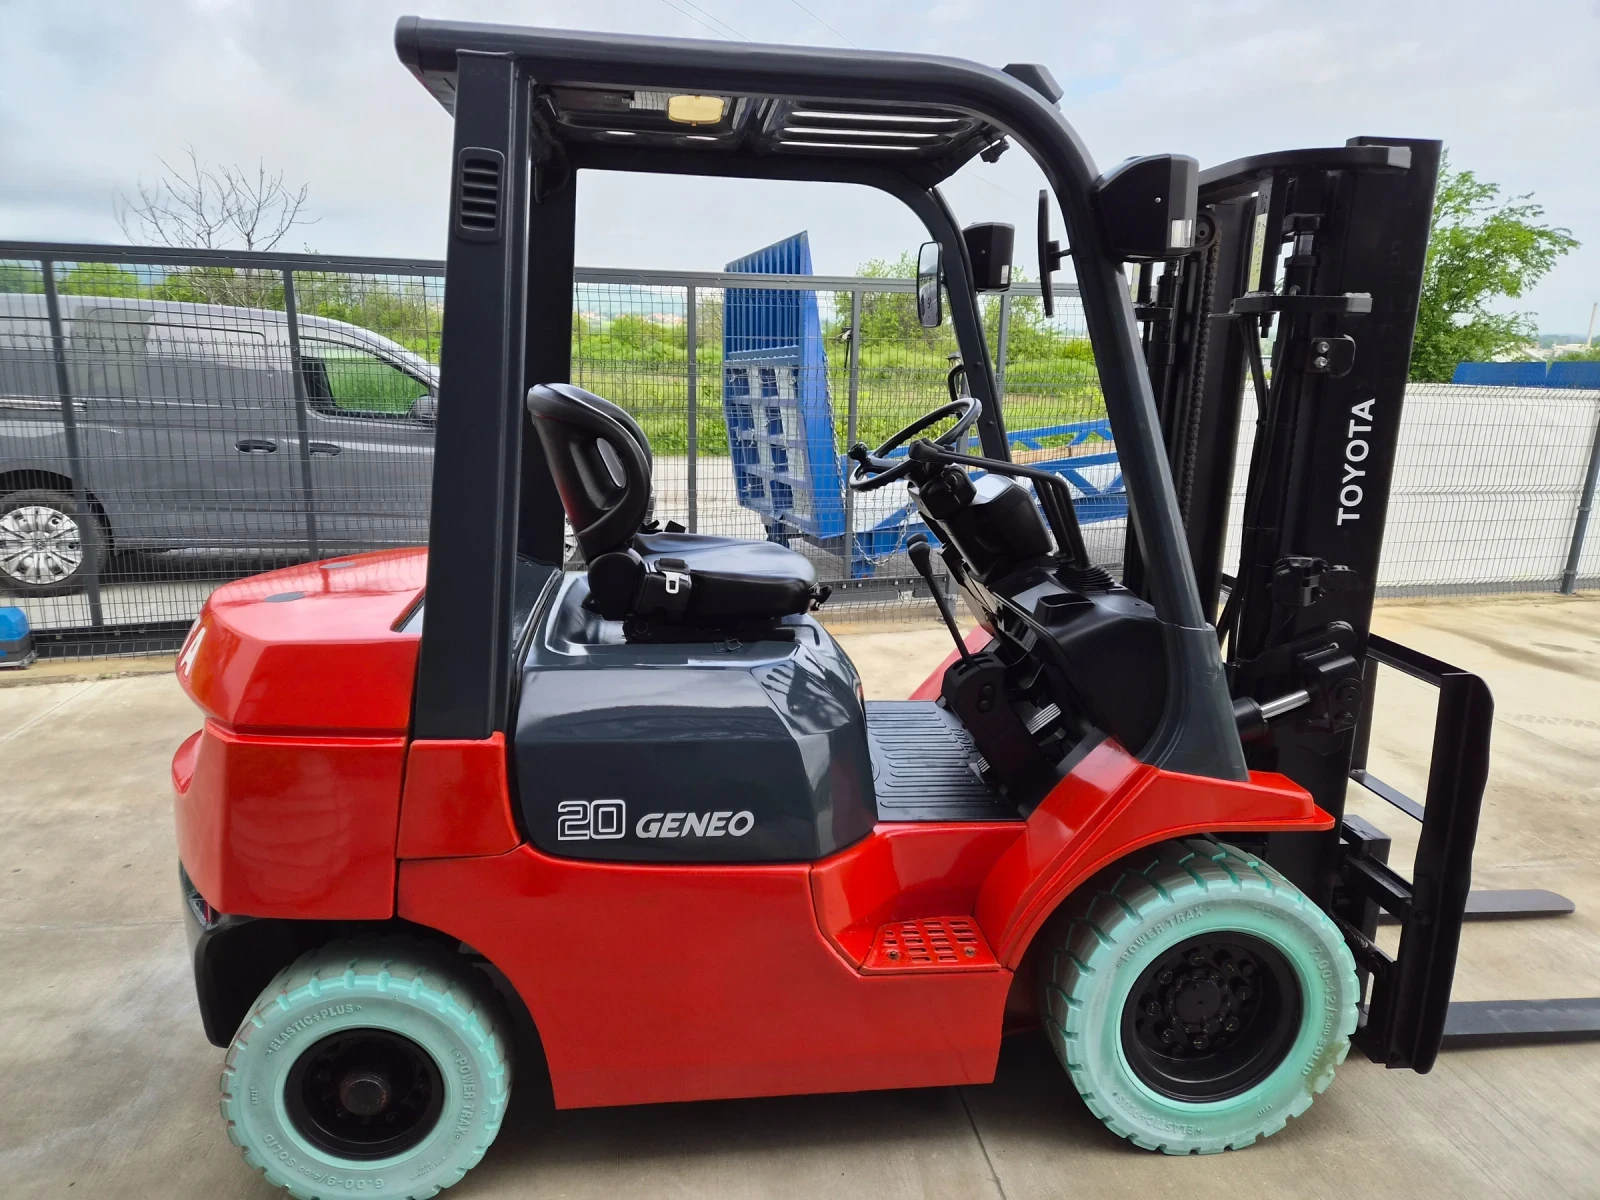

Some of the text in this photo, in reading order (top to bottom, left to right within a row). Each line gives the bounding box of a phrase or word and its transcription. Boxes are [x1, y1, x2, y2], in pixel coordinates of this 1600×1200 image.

[1337, 398, 1376, 526] TOYOTA
[557, 799, 755, 841] 20 GENEO
[1120, 906, 1204, 963] POWER TRAX
[1301, 945, 1338, 1077] 7.00-12/5.00 SOLID
[455, 1057, 476, 1136] POWER TRAX
[263, 1133, 297, 1168] SOLID
[298, 1165, 385, 1190] 6.00-9/4.00
